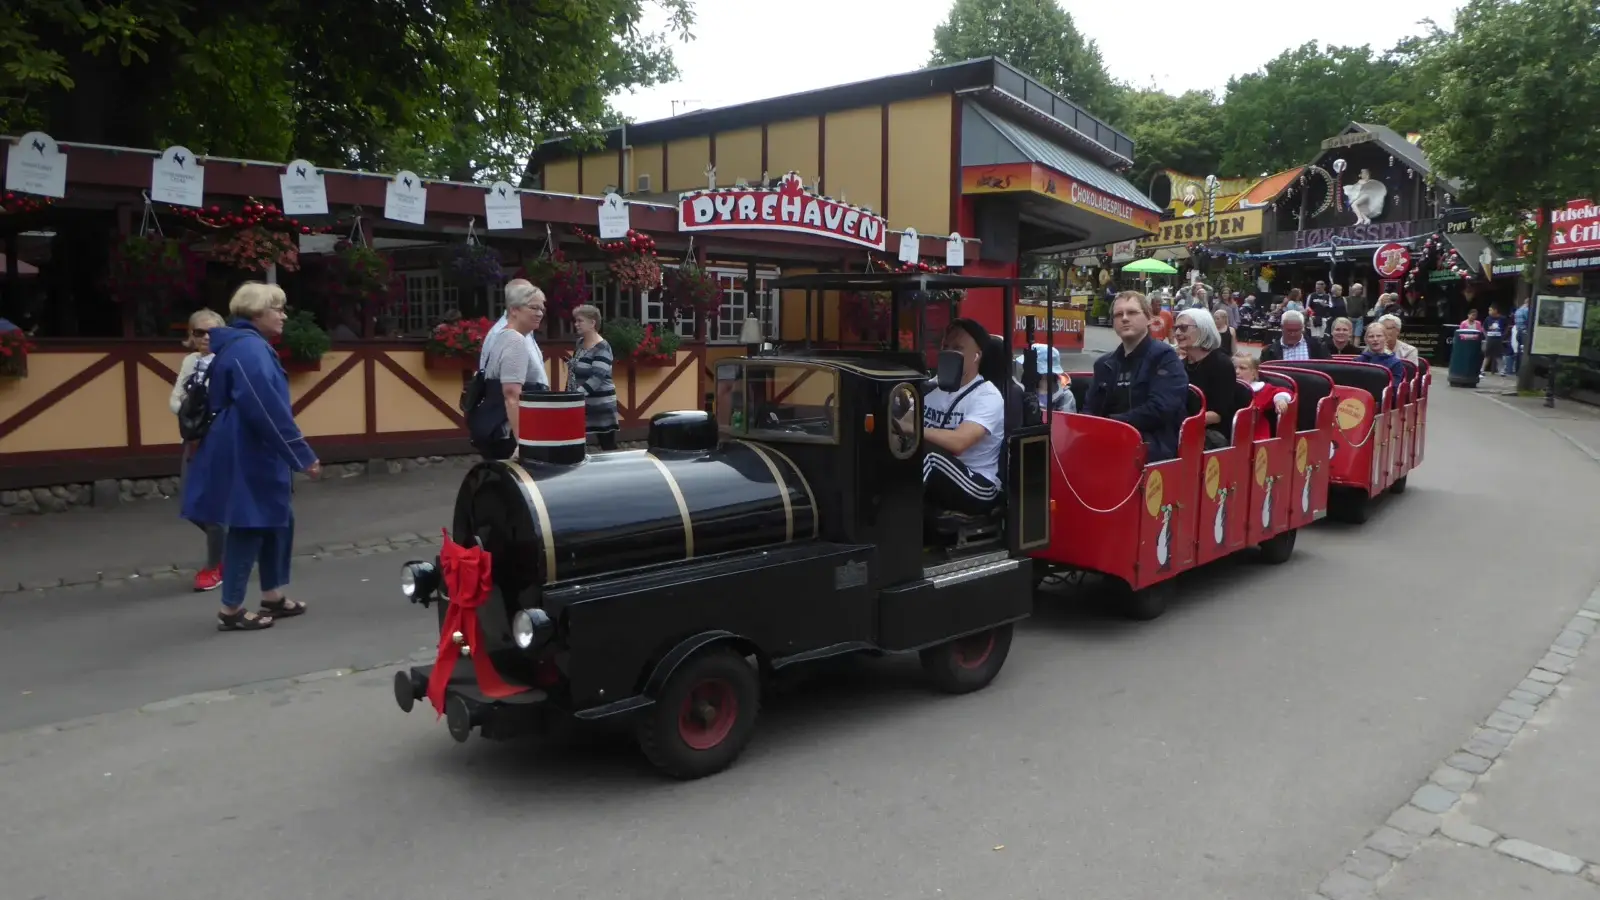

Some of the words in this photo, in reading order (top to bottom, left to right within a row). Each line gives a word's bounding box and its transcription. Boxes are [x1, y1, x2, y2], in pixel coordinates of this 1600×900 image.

[692, 194, 878, 241] DYREHAVEN
[1071, 182, 1133, 220] CHOKOLADESPILLET
[1142, 216, 1245, 242] FESTUEN
[1294, 221, 1412, 249] HØKASSEN
